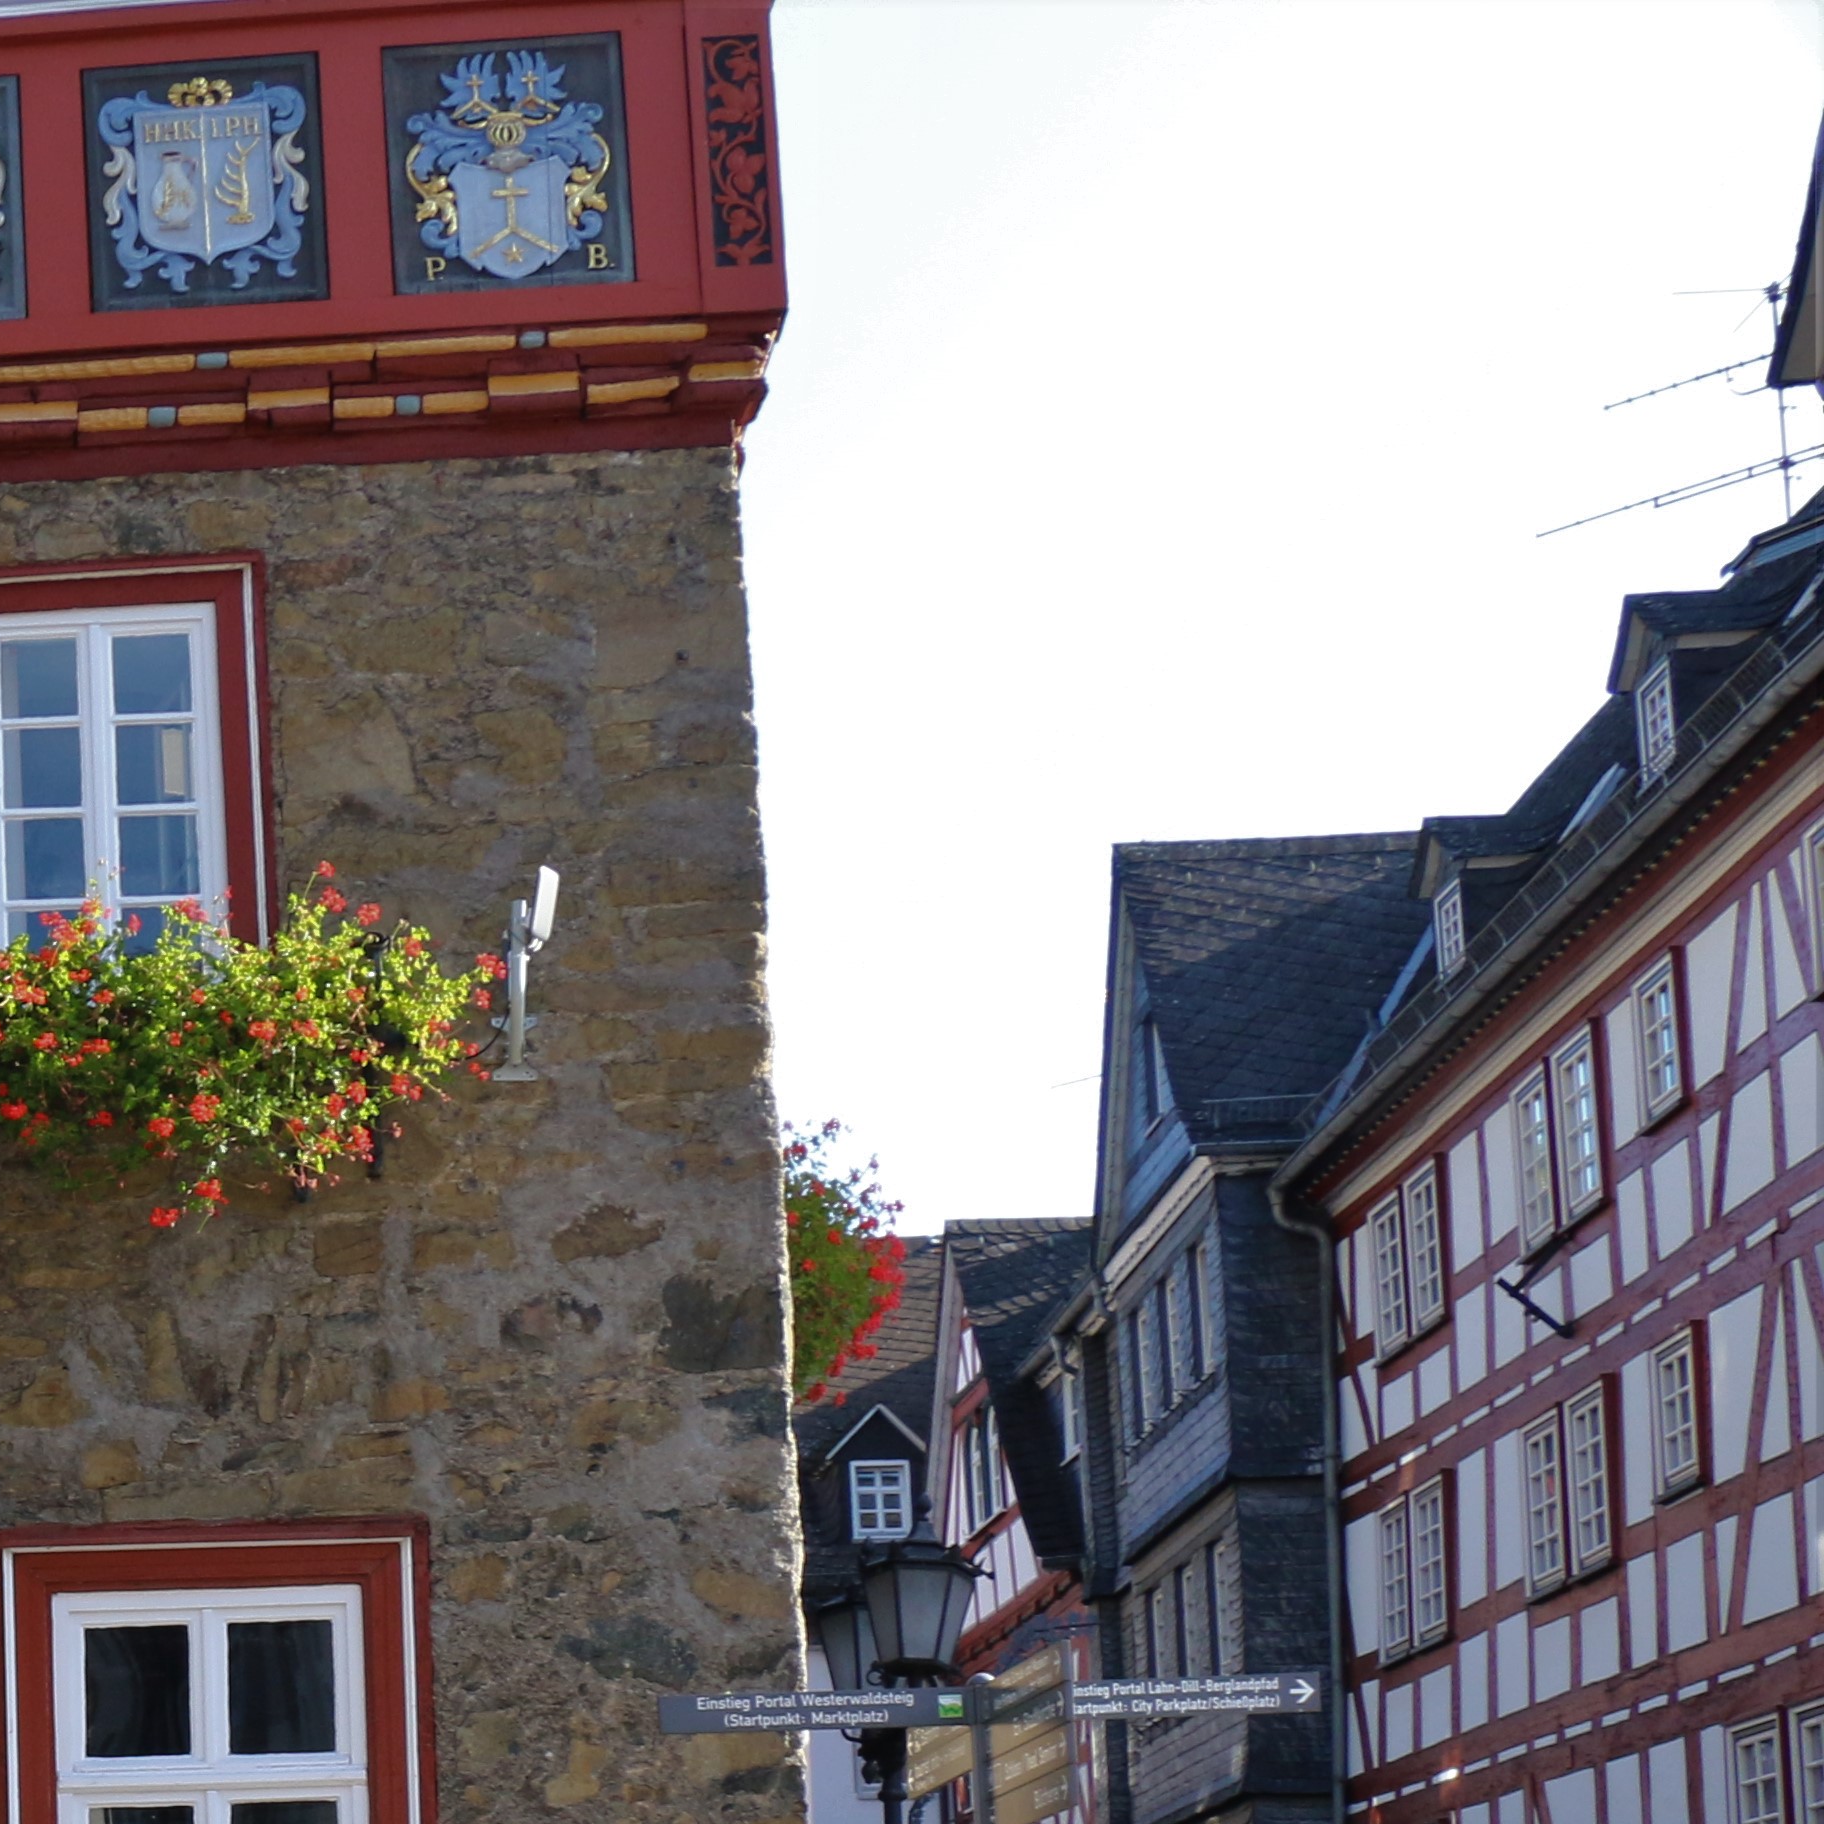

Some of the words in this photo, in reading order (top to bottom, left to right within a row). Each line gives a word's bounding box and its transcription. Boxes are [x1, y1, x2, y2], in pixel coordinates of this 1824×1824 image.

[1073, 1682, 1110, 1700] instieg
[1113, 1681, 1145, 1697] Portal
[1148, 1677, 1280, 1695] Lahn-Dill-Berglandpfad
[696, 1696, 751, 1711] Einstieg
[755, 1694, 797, 1708] Portal
[801, 1691, 915, 1707] Westerwaldsteig
[1073, 1699, 1129, 1717] tartpunkt:
[1131, 1699, 1153, 1715] City
[723, 1712, 806, 1729] (Startpunkt:
[811, 1708, 890, 1726] Marktplatz)
